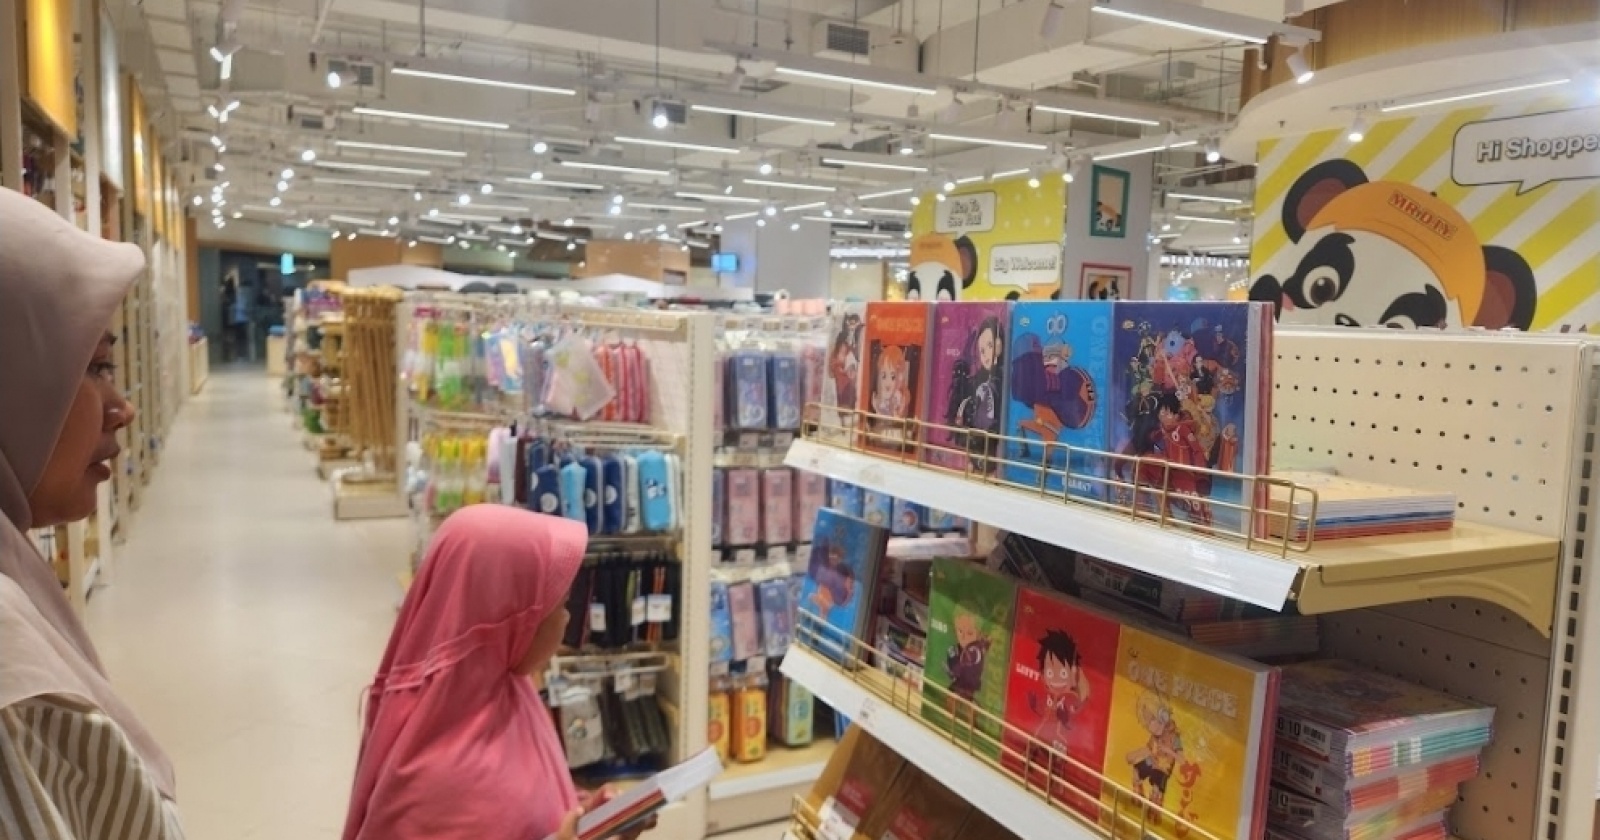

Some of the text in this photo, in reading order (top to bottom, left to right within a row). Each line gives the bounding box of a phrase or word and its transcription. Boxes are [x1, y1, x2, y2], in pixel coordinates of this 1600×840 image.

[1477, 133, 1600, 163] Hi Shoppe
[951, 199, 981, 214] Nice To
[947, 216, 963, 227] See
[993, 255, 1057, 273] Big Welcome!
[1128, 660, 1238, 718] ONE PIECE
